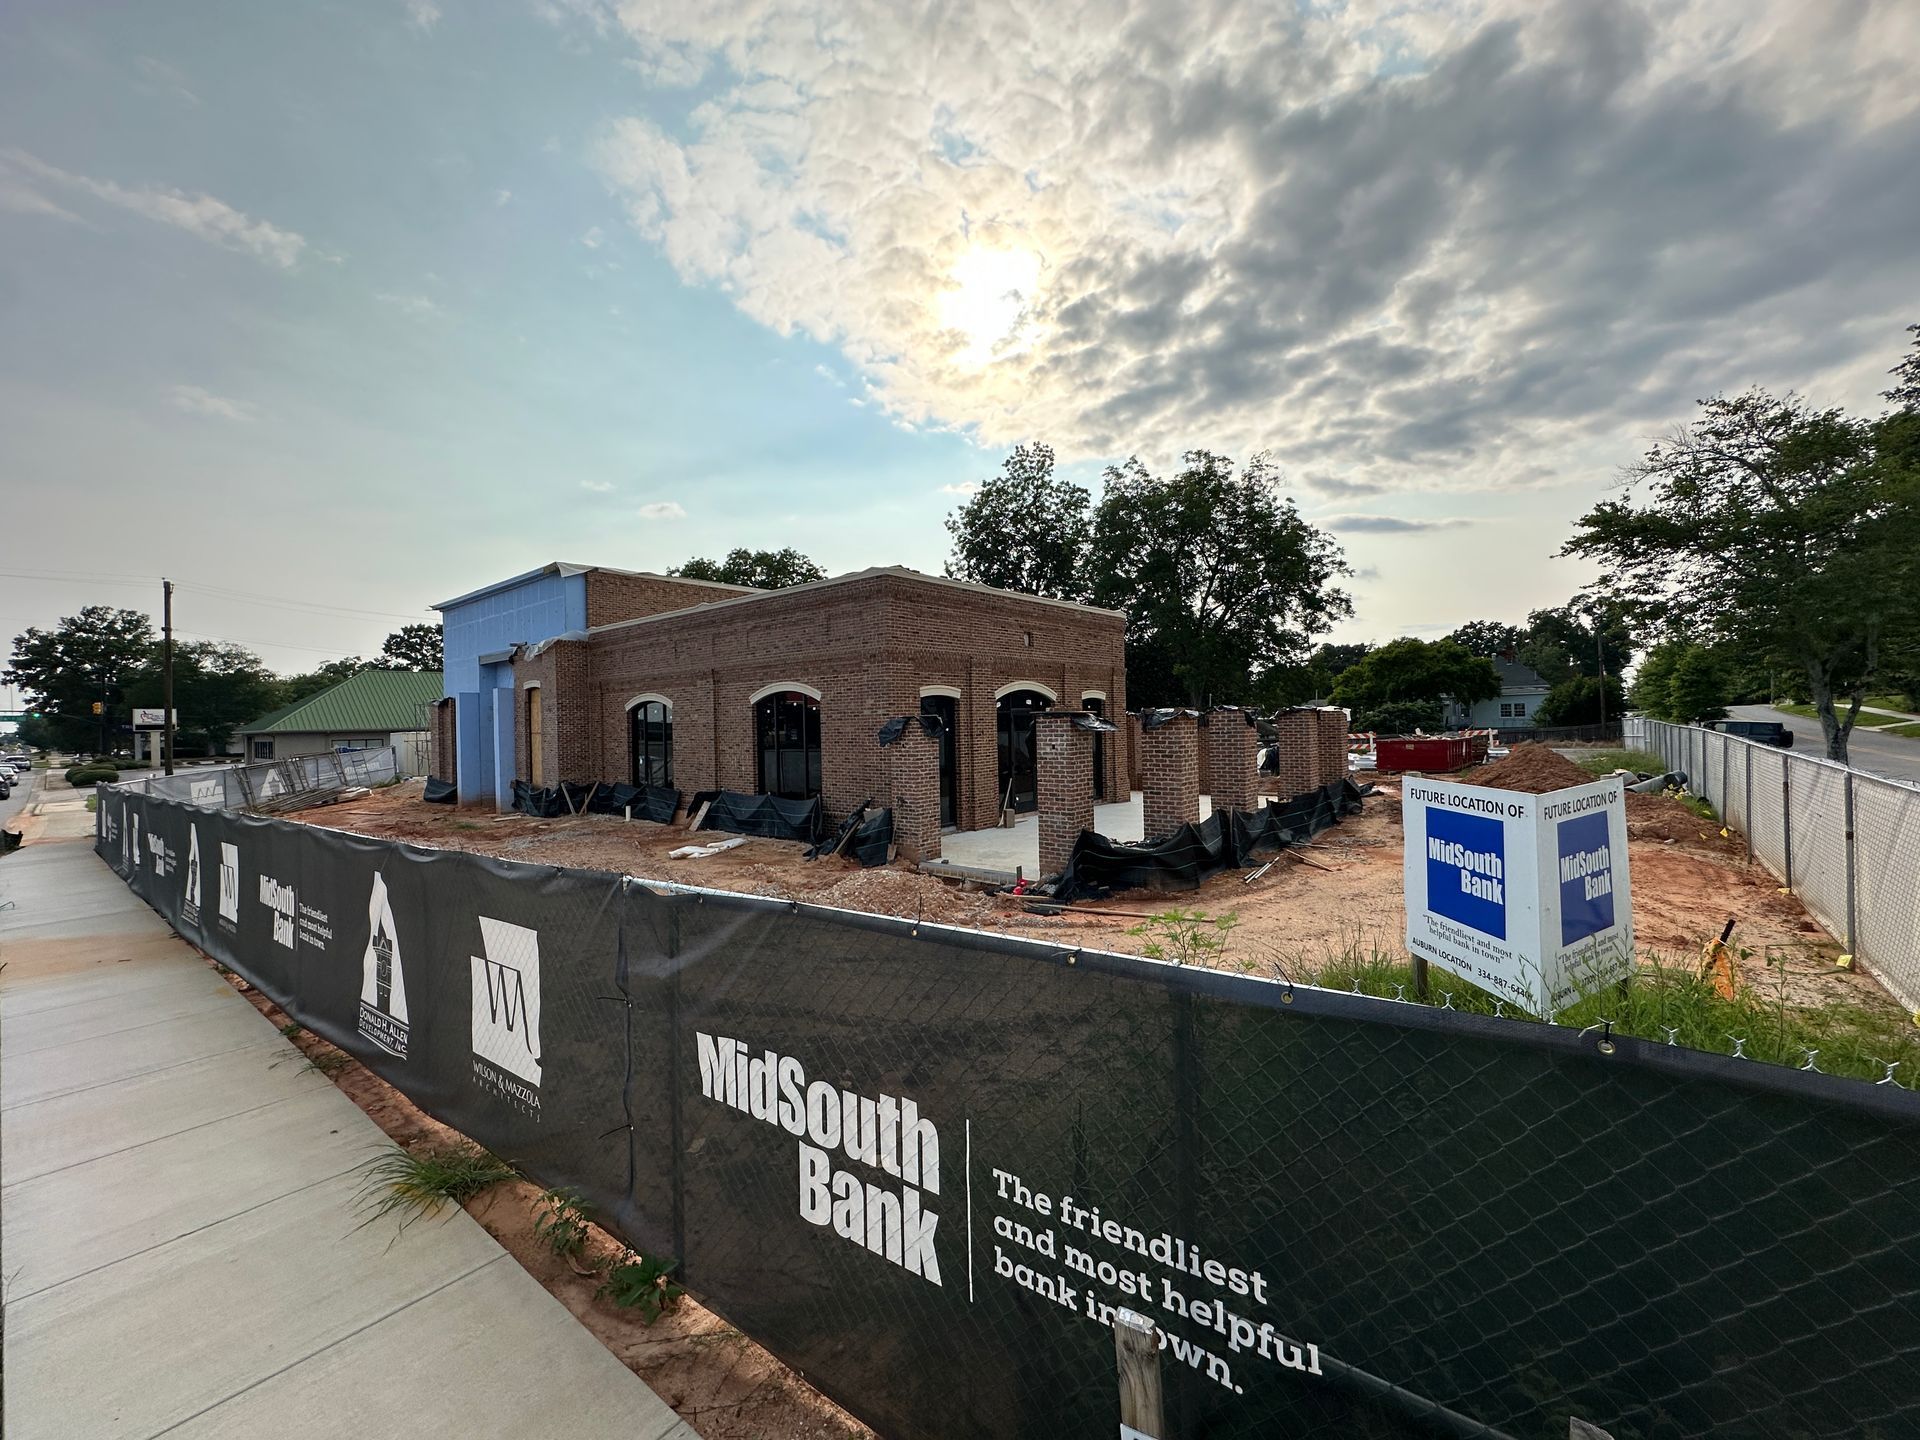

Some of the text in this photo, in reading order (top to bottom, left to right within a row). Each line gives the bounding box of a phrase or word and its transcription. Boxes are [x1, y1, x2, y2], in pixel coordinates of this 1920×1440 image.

[1410, 788, 1525, 818] FUTURE LOCATION OF
[1544, 791, 1618, 820] FUTURE LOCATION OF
[1428, 836, 1502, 879] MidSouth
[1560, 845, 1610, 884] MidSouth
[260, 874, 295, 917] MidSouth
[1461, 868, 1504, 905] Bank
[1584, 870, 1611, 901] Bank
[273, 910, 294, 950] Bank
[1429, 926, 1451, 942] helpful
[1453, 936, 1470, 950] bank
[1472, 944, 1479, 954] in
[1440, 921, 1475, 942] friendliest
[1477, 938, 1491, 950] and
[1492, 947, 1513, 959] most
[1412, 937, 1437, 955] AUBURN
[1439, 949, 1472, 972] LOCATION
[360, 1007, 381, 1028] DONALD
[389, 1023, 408, 1045] ALLEN
[472, 1060, 541, 1109] WILSON & MAZZOLA
[696, 1031, 940, 1195] MidSouth
[799, 1140, 942, 1287] Bank
[992, 1168, 1268, 1305] The friendliest
[993, 1215, 1323, 1376] and most helpful
[994, 1245, 1244, 1395] bank in own.
